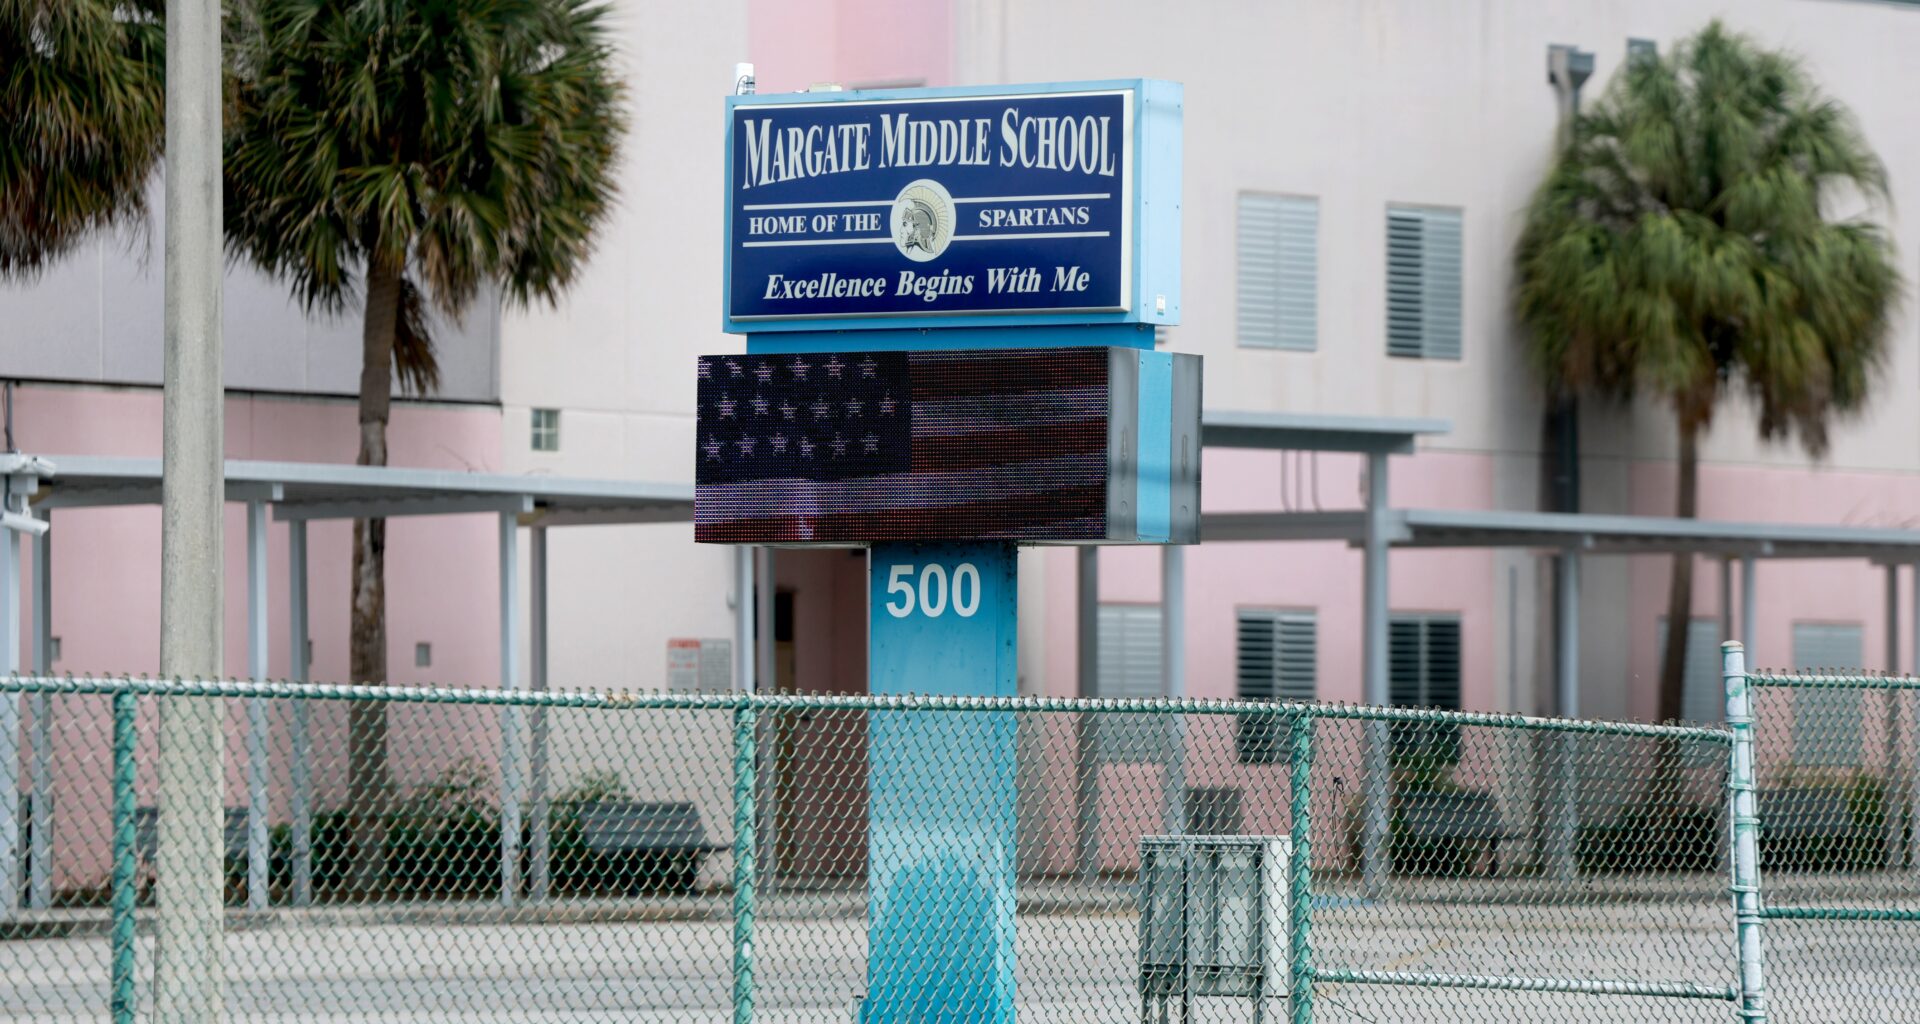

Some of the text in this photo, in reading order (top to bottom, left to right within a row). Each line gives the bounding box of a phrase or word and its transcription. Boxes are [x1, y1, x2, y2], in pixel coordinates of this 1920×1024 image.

[742, 107, 1115, 190] MARGATE MIDDLE SCHOOL
[749, 206, 1090, 235] HOME OF THE SPARTANS
[763, 266, 1090, 302] Excellence Begins With Me
[886, 563, 981, 618] 500
